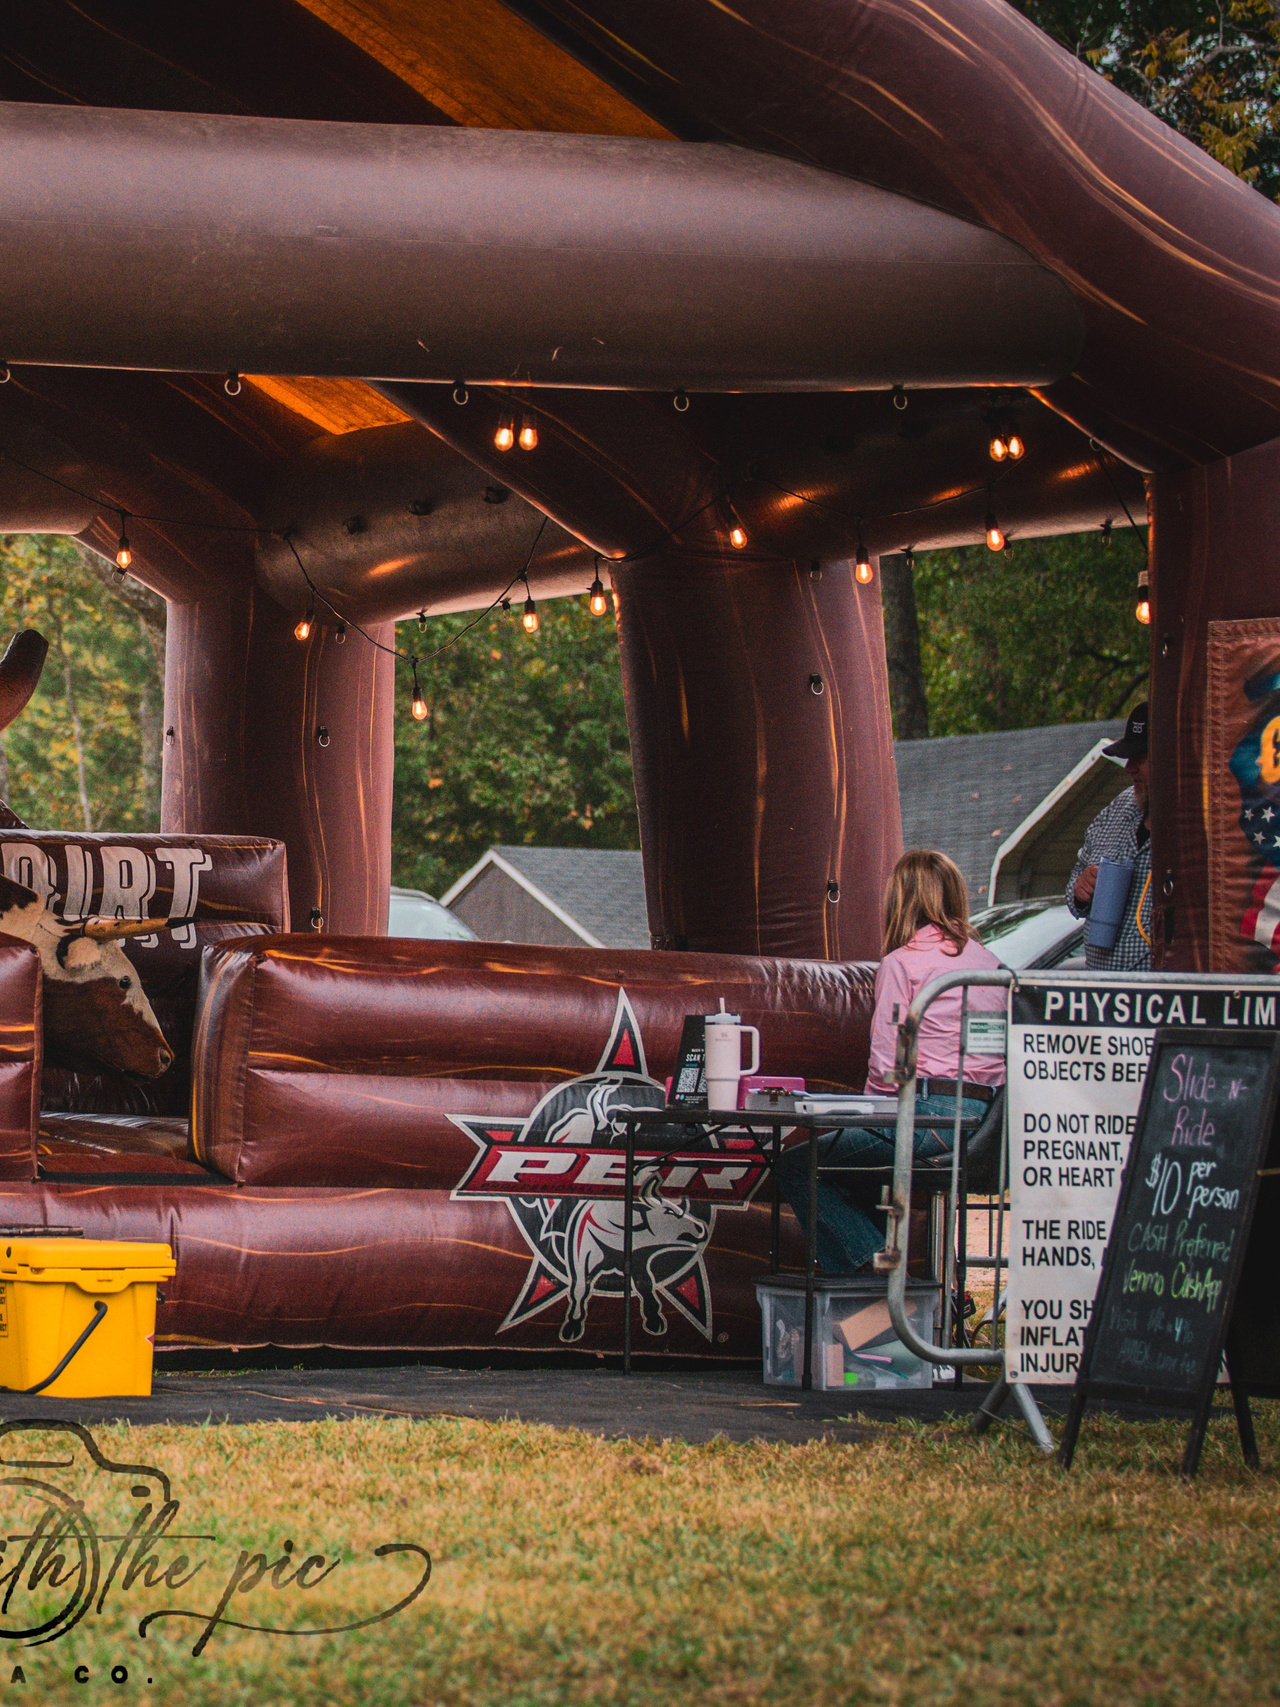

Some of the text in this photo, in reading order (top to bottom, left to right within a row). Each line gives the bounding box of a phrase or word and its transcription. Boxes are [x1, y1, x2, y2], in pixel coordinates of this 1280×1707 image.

[1044, 991, 1276, 1026] PHYSICAL LIM
[1024, 1033, 1101, 1055] REMOVE
[1023, 1060, 1106, 1081] OBJECTS
[1163, 1053, 1215, 1102] Slide
[1024, 1113, 1138, 1135] DO NOT RIDE
[1171, 1105, 1215, 1146] Ride
[1024, 1140, 1123, 1165] PREGNANT,
[1023, 1166, 1115, 1187] OR HEART
[1145, 1152, 1217, 1216] $10 per
[1188, 1185, 1240, 1219] person
[1022, 1220, 1107, 1240] THE RIDE
[1022, 1247, 1095, 1270] HANDS,
[1021, 1300, 1062, 1320] YOU
[1020, 1353, 1083, 1373] INJUR
